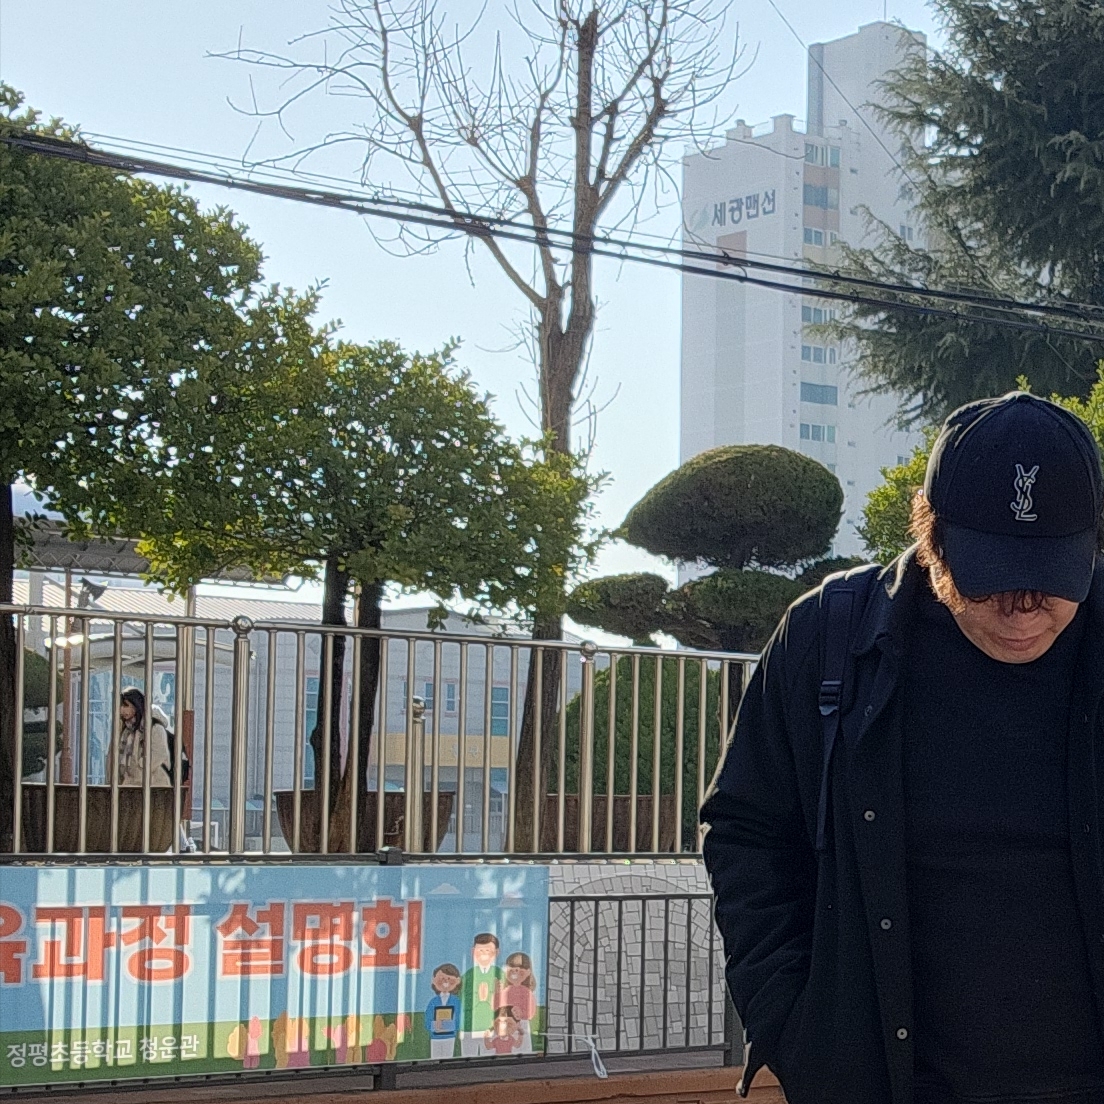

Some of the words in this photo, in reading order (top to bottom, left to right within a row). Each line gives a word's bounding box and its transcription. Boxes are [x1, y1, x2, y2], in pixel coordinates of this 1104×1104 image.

[711, 189, 776, 227] 세광맨션
[215, 899, 423, 977] 설명회
[6, 1038, 133, 1068] 정평초등학교
[139, 1034, 200, 1061] 청운관
